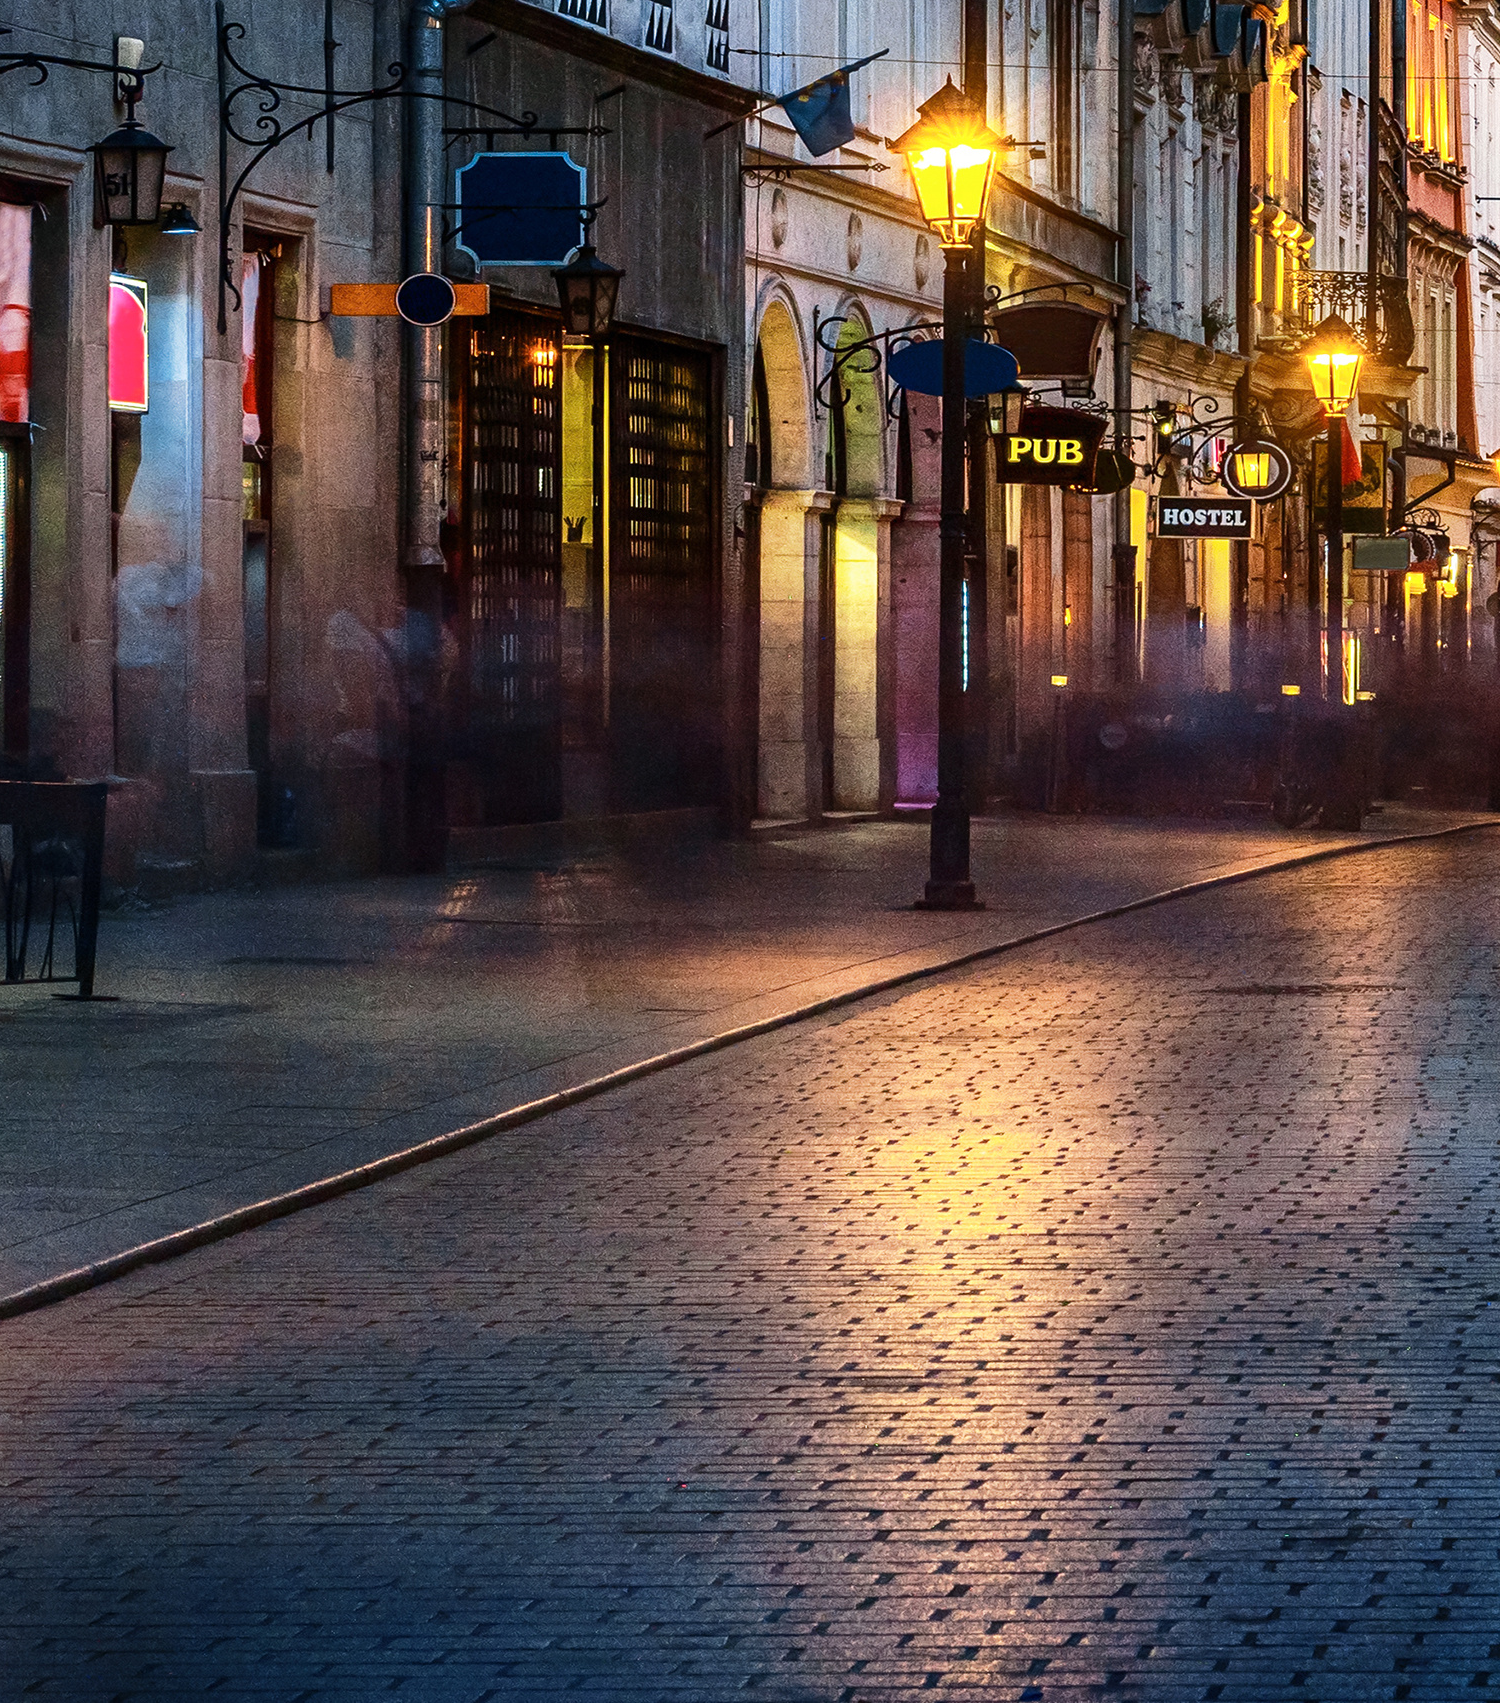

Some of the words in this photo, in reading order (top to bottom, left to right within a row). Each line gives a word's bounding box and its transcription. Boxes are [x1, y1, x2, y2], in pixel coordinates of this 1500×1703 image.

[105, 172, 129, 197] 51
[1008, 437, 1084, 464] PUB
[1163, 508, 1246, 527] HOSTEL
